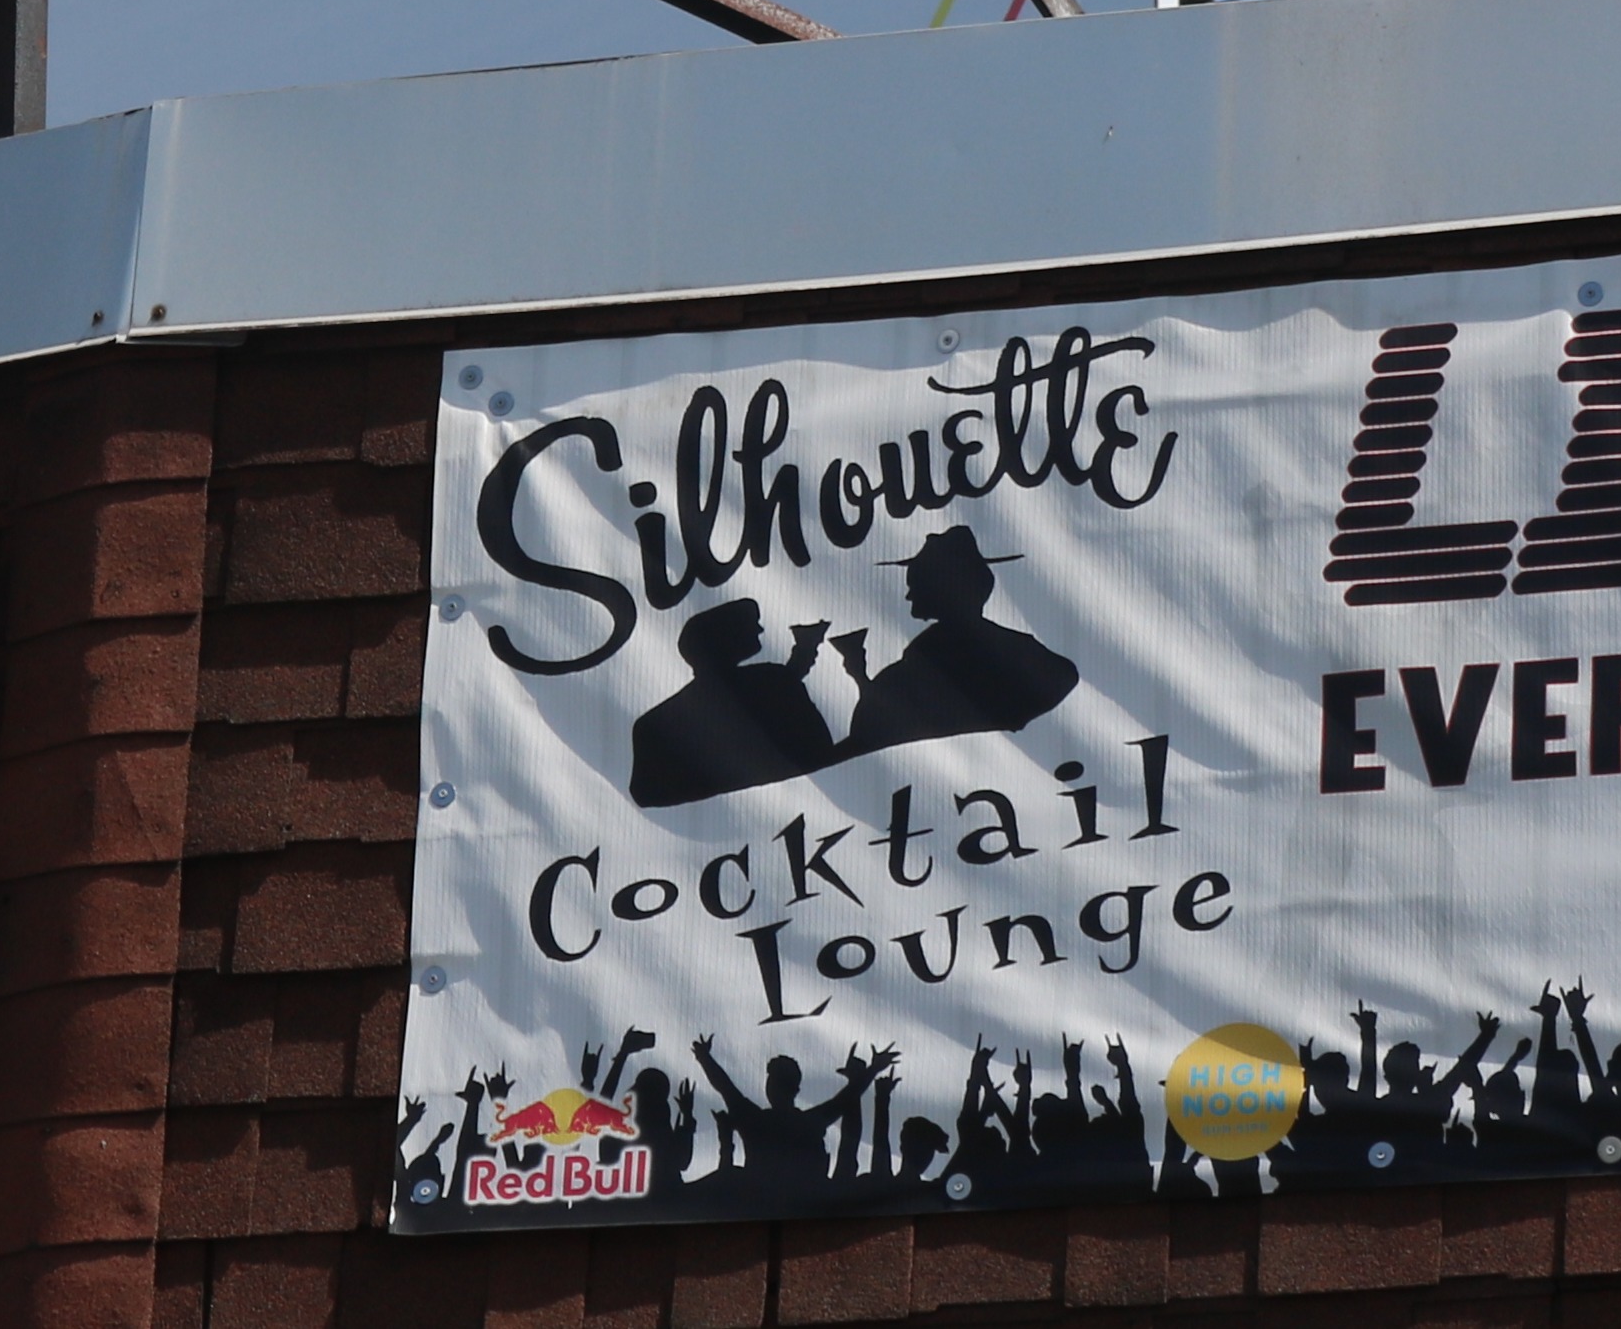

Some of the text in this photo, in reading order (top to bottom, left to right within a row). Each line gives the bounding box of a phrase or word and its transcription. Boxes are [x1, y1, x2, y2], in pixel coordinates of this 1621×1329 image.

[476, 325, 1178, 677] Silhouette
[529, 734, 1180, 963] Cocktail
[735, 869, 1234, 1026] Lounge
[1182, 1090, 1286, 1117] NOON
[1189, 1062, 1282, 1088] HIGH
[468, 1151, 647, 1201] Red Bull
